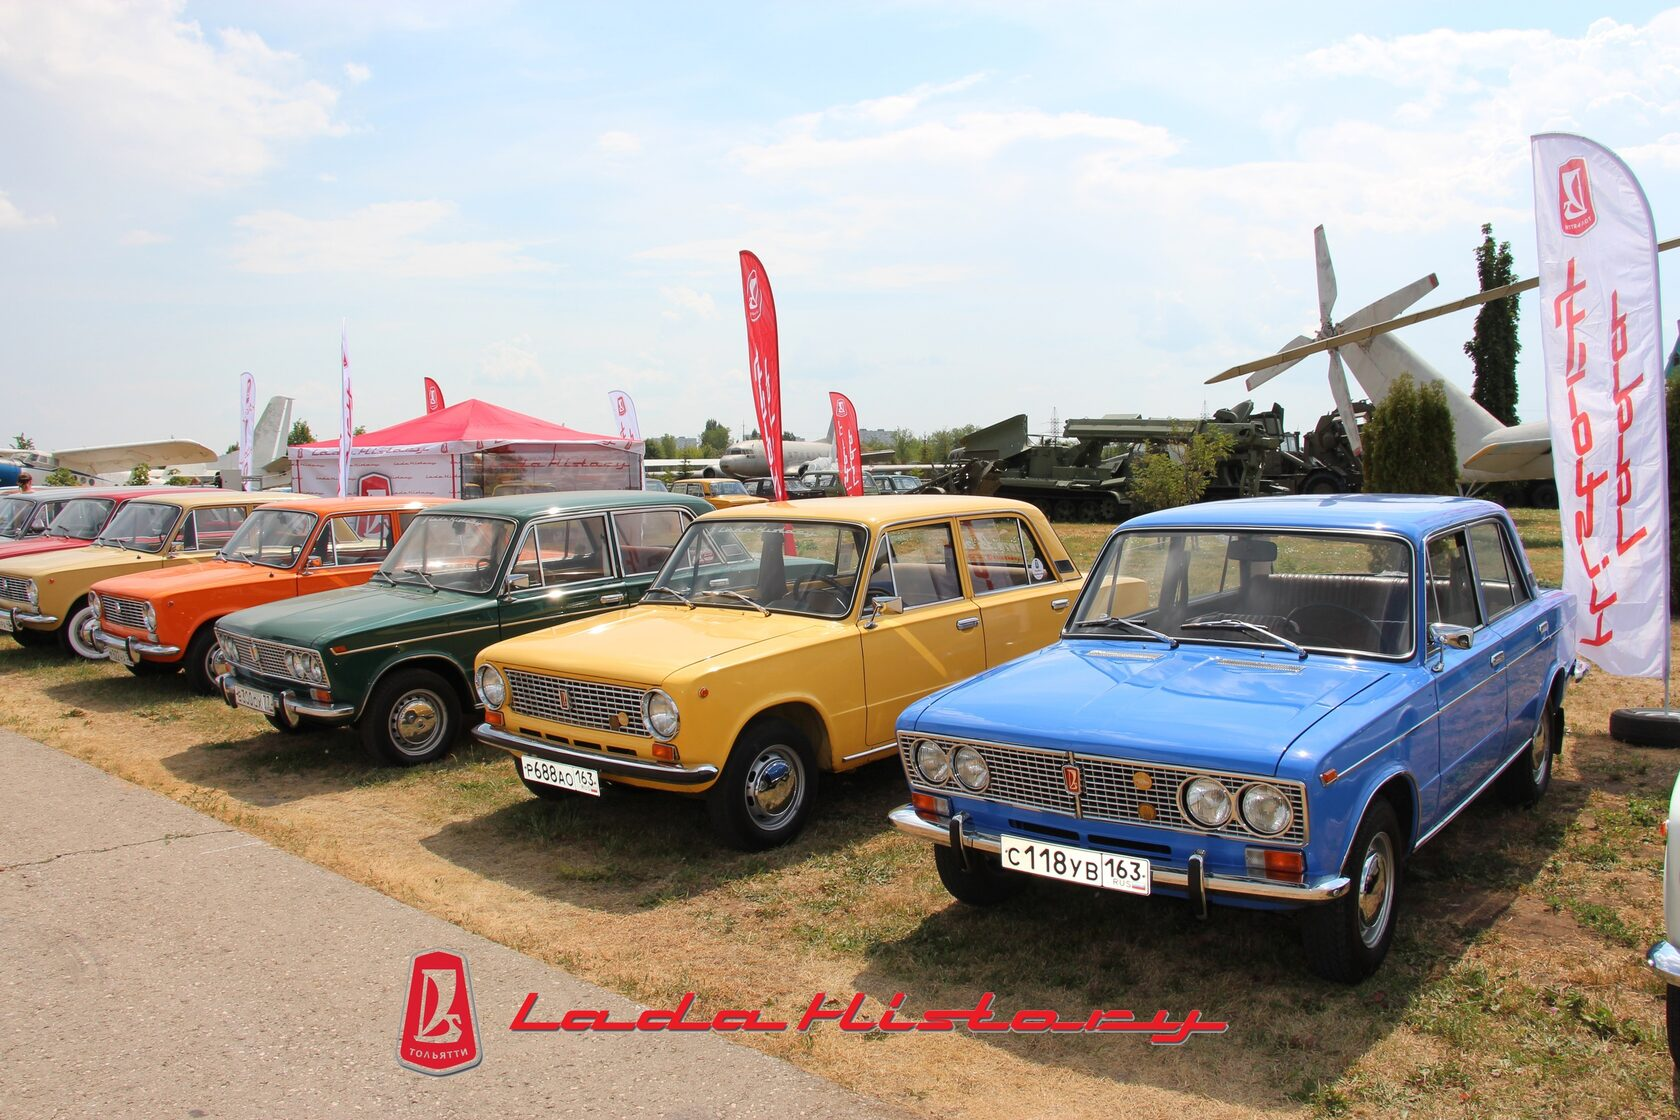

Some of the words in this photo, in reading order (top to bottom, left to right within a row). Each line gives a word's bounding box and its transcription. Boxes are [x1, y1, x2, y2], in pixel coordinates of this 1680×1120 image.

[575, 769, 594, 787] 163
[1007, 845, 1098, 881] С118УВ
[1104, 858, 1141, 881] 163
[1112, 877, 1132, 889] RUS
